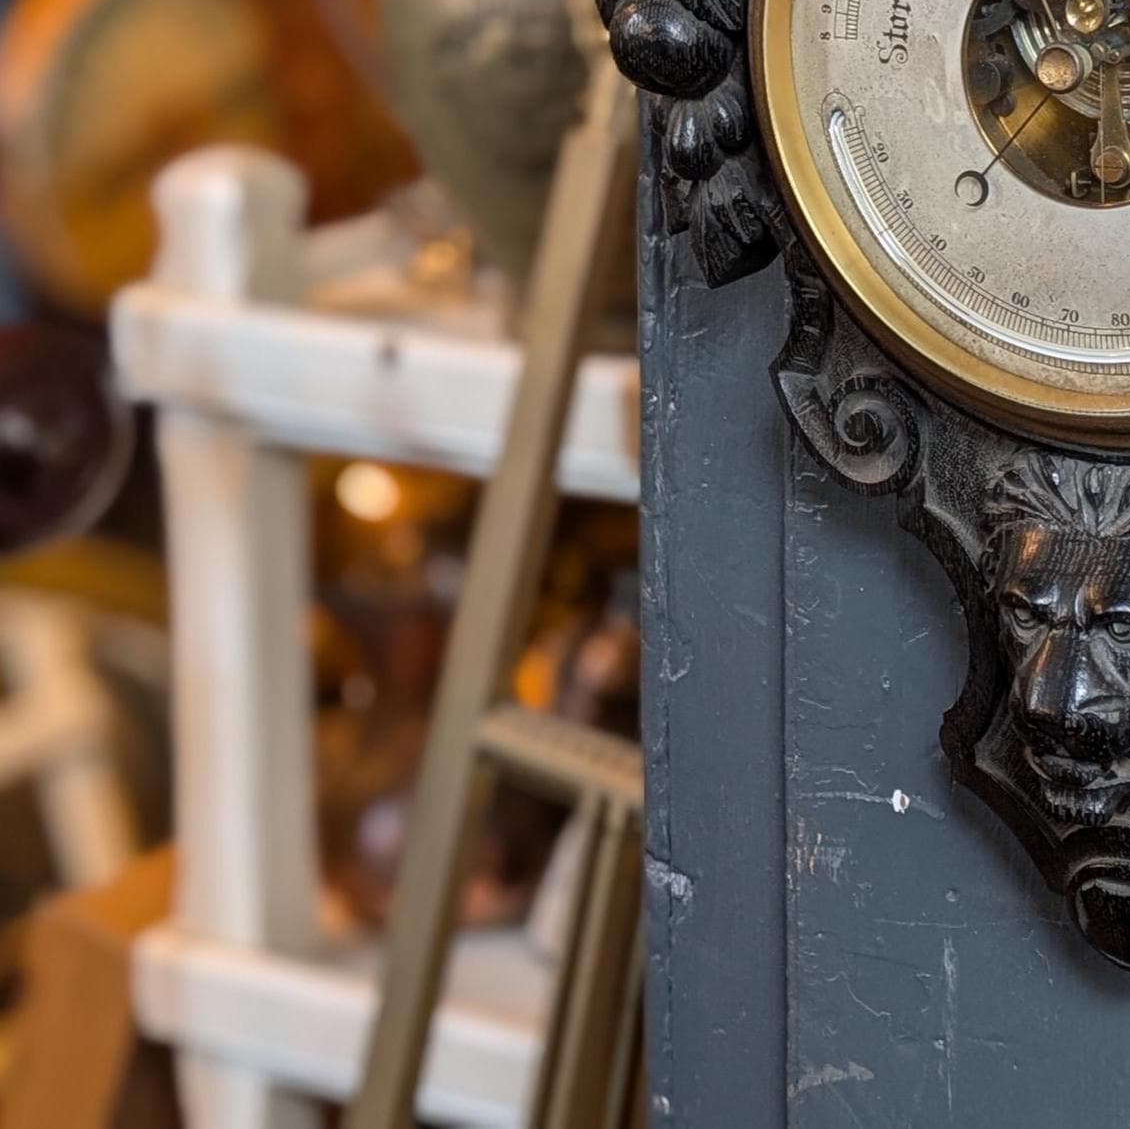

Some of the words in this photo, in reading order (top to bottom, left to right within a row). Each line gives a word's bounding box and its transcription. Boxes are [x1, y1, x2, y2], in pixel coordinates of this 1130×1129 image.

[821, 4, 832, 14] 9
[820, 31, 832, 41] 8
[872, 142, 889, 164] 20
[896, 189, 914, 210] 30
[929, 234, 948, 252] 40
[966, 266, 986, 284] 50
[1011, 291, 1030, 309] 60
[1060, 307, 1079, 323] 70
[1111, 313, 1130, 327] 80
